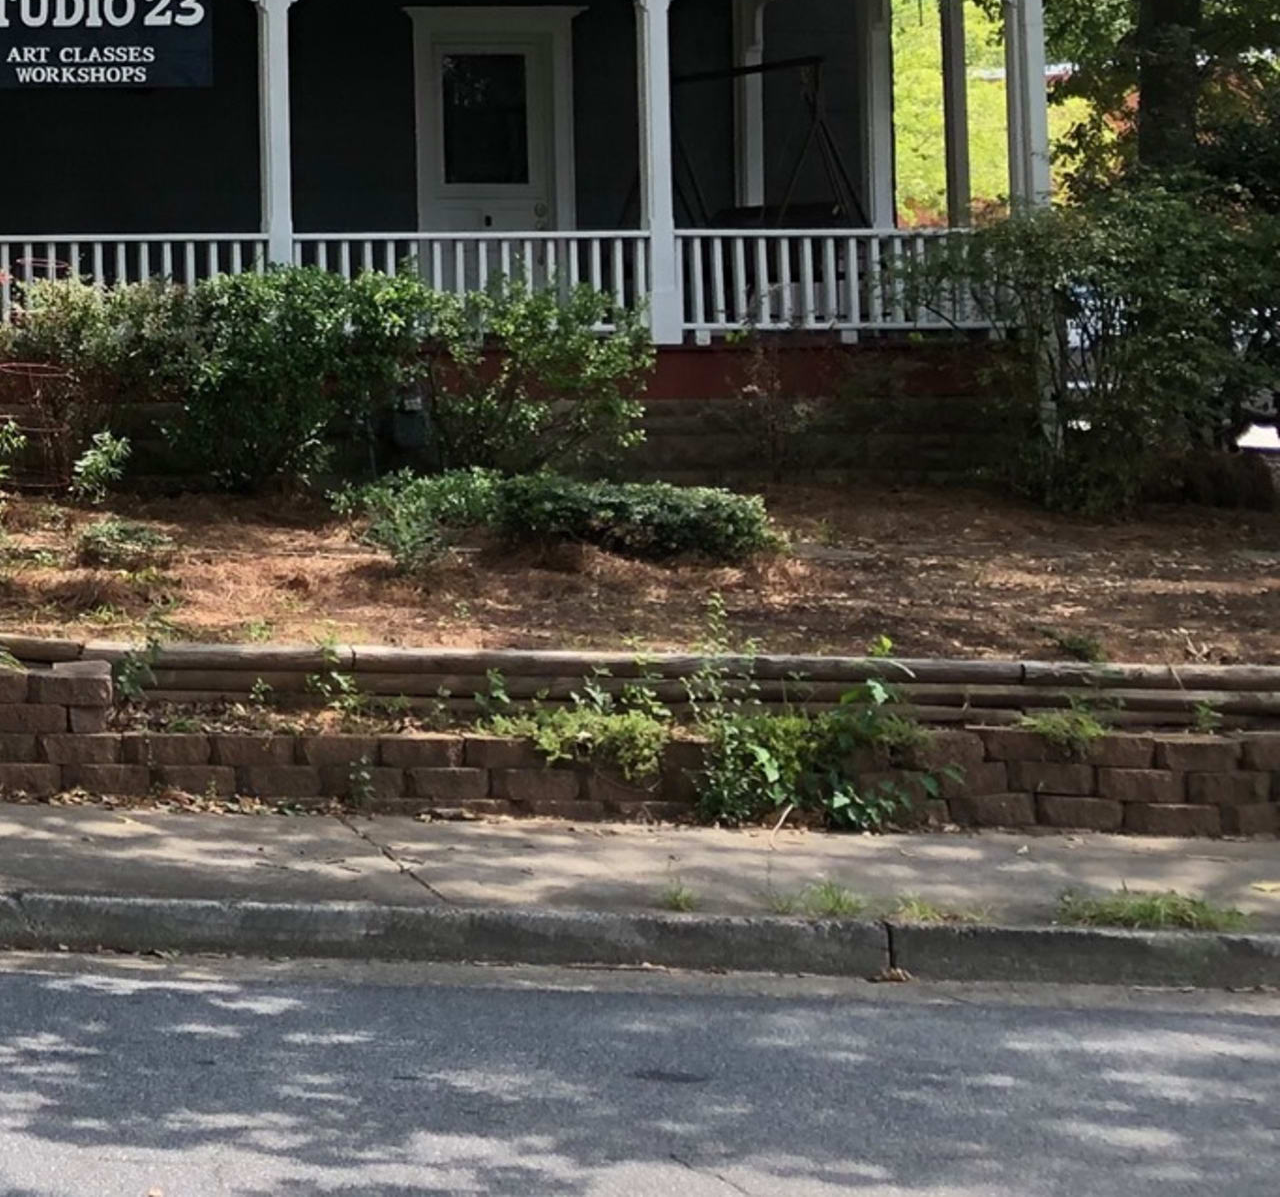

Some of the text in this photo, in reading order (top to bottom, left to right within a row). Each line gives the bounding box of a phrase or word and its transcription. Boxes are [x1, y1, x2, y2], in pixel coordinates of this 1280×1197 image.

[6, 47, 155, 63] ART CLASSES
[16, 66, 147, 83] WORKSHOPS
